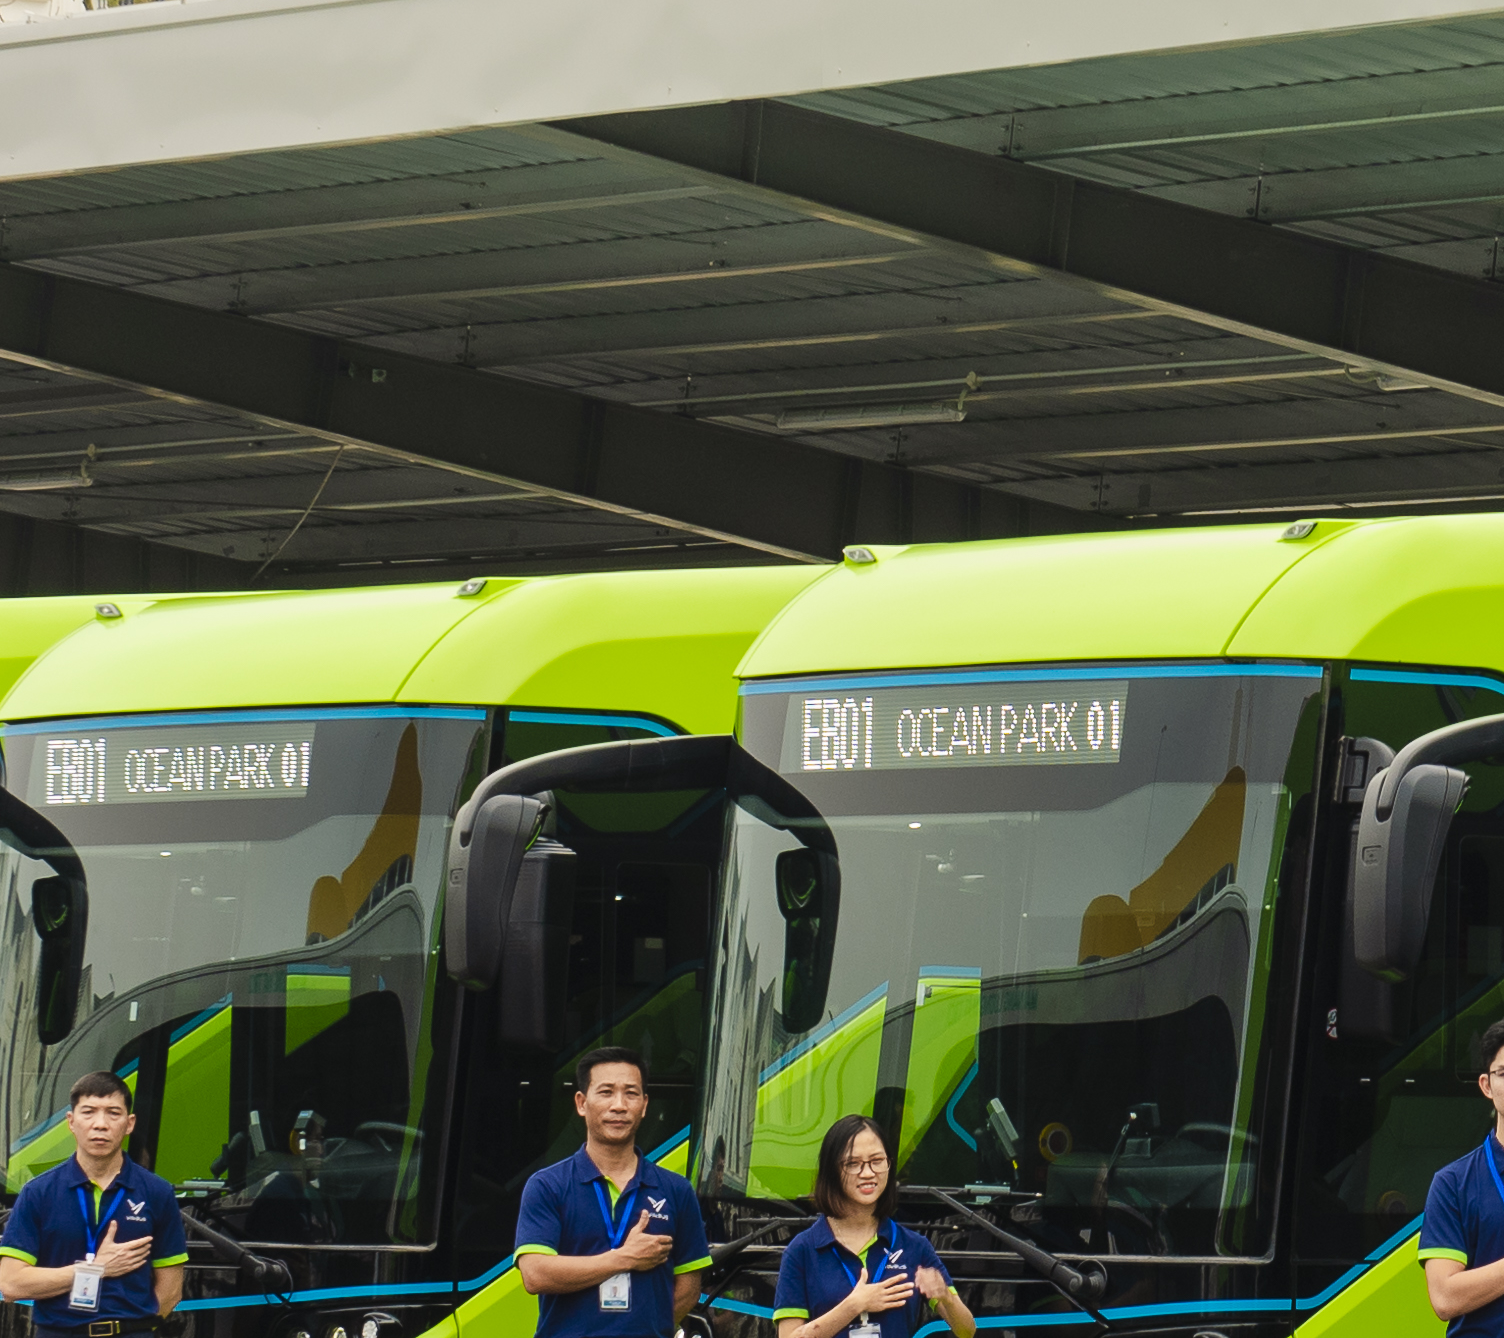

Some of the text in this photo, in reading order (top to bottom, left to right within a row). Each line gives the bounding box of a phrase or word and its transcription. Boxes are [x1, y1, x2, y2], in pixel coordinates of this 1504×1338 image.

[800, 696, 1121, 770] EB01 OCEAN PARK 01
[45, 736, 311, 804] EB01 OCEAN PARK 01
